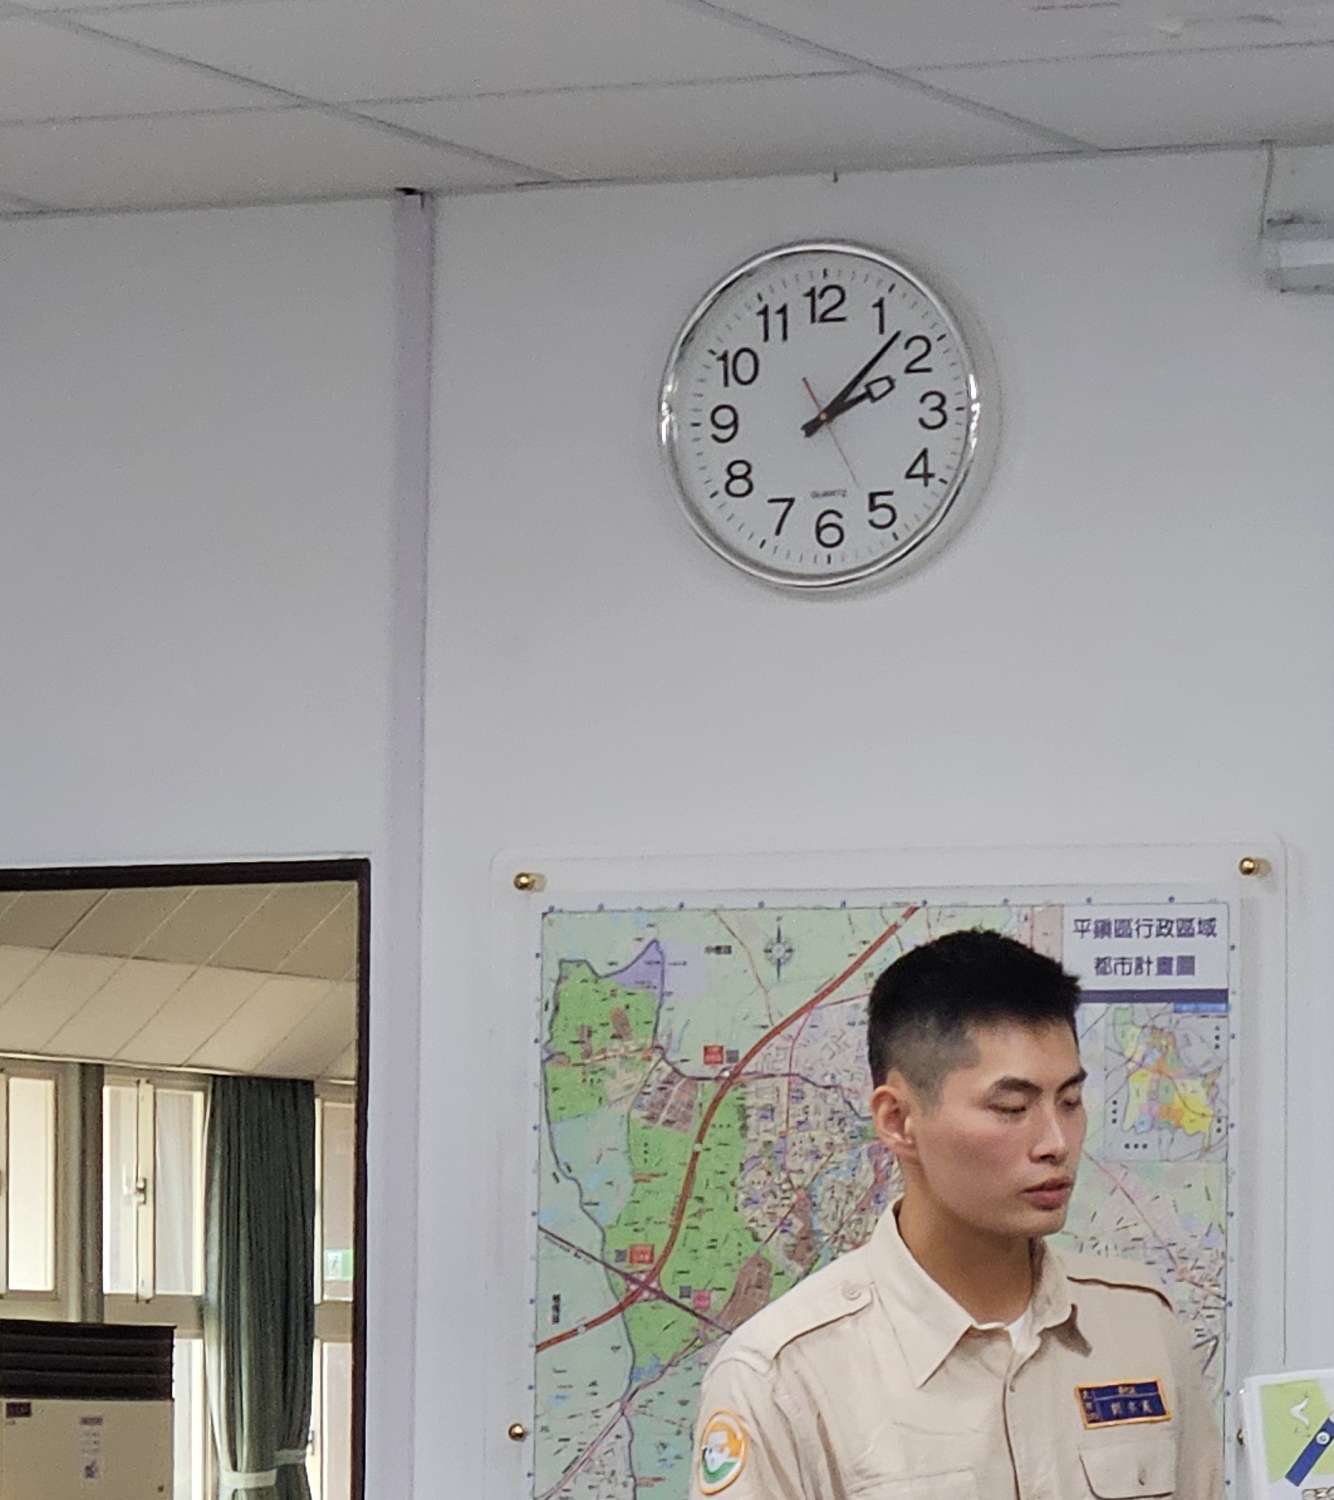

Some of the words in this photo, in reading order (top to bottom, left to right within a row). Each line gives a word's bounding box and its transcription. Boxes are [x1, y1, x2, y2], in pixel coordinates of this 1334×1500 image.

[756, 303, 788, 343] 11
[803, 284, 846, 324] 12
[872, 297, 885, 334] 1
[716, 347, 759, 387] 10
[904, 334, 933, 373] 2
[710, 404, 738, 443] 9
[918, 391, 947, 430] 3
[725, 460, 754, 498] 8
[905, 448, 935, 487] 4
[767, 497, 796, 536] 7
[815, 510, 845, 548] 6
[868, 490, 898, 529] 5
[1073, 917, 1217, 939] 平鎮區行政區域
[1094, 955, 1196, 976] 都市計畫圖
